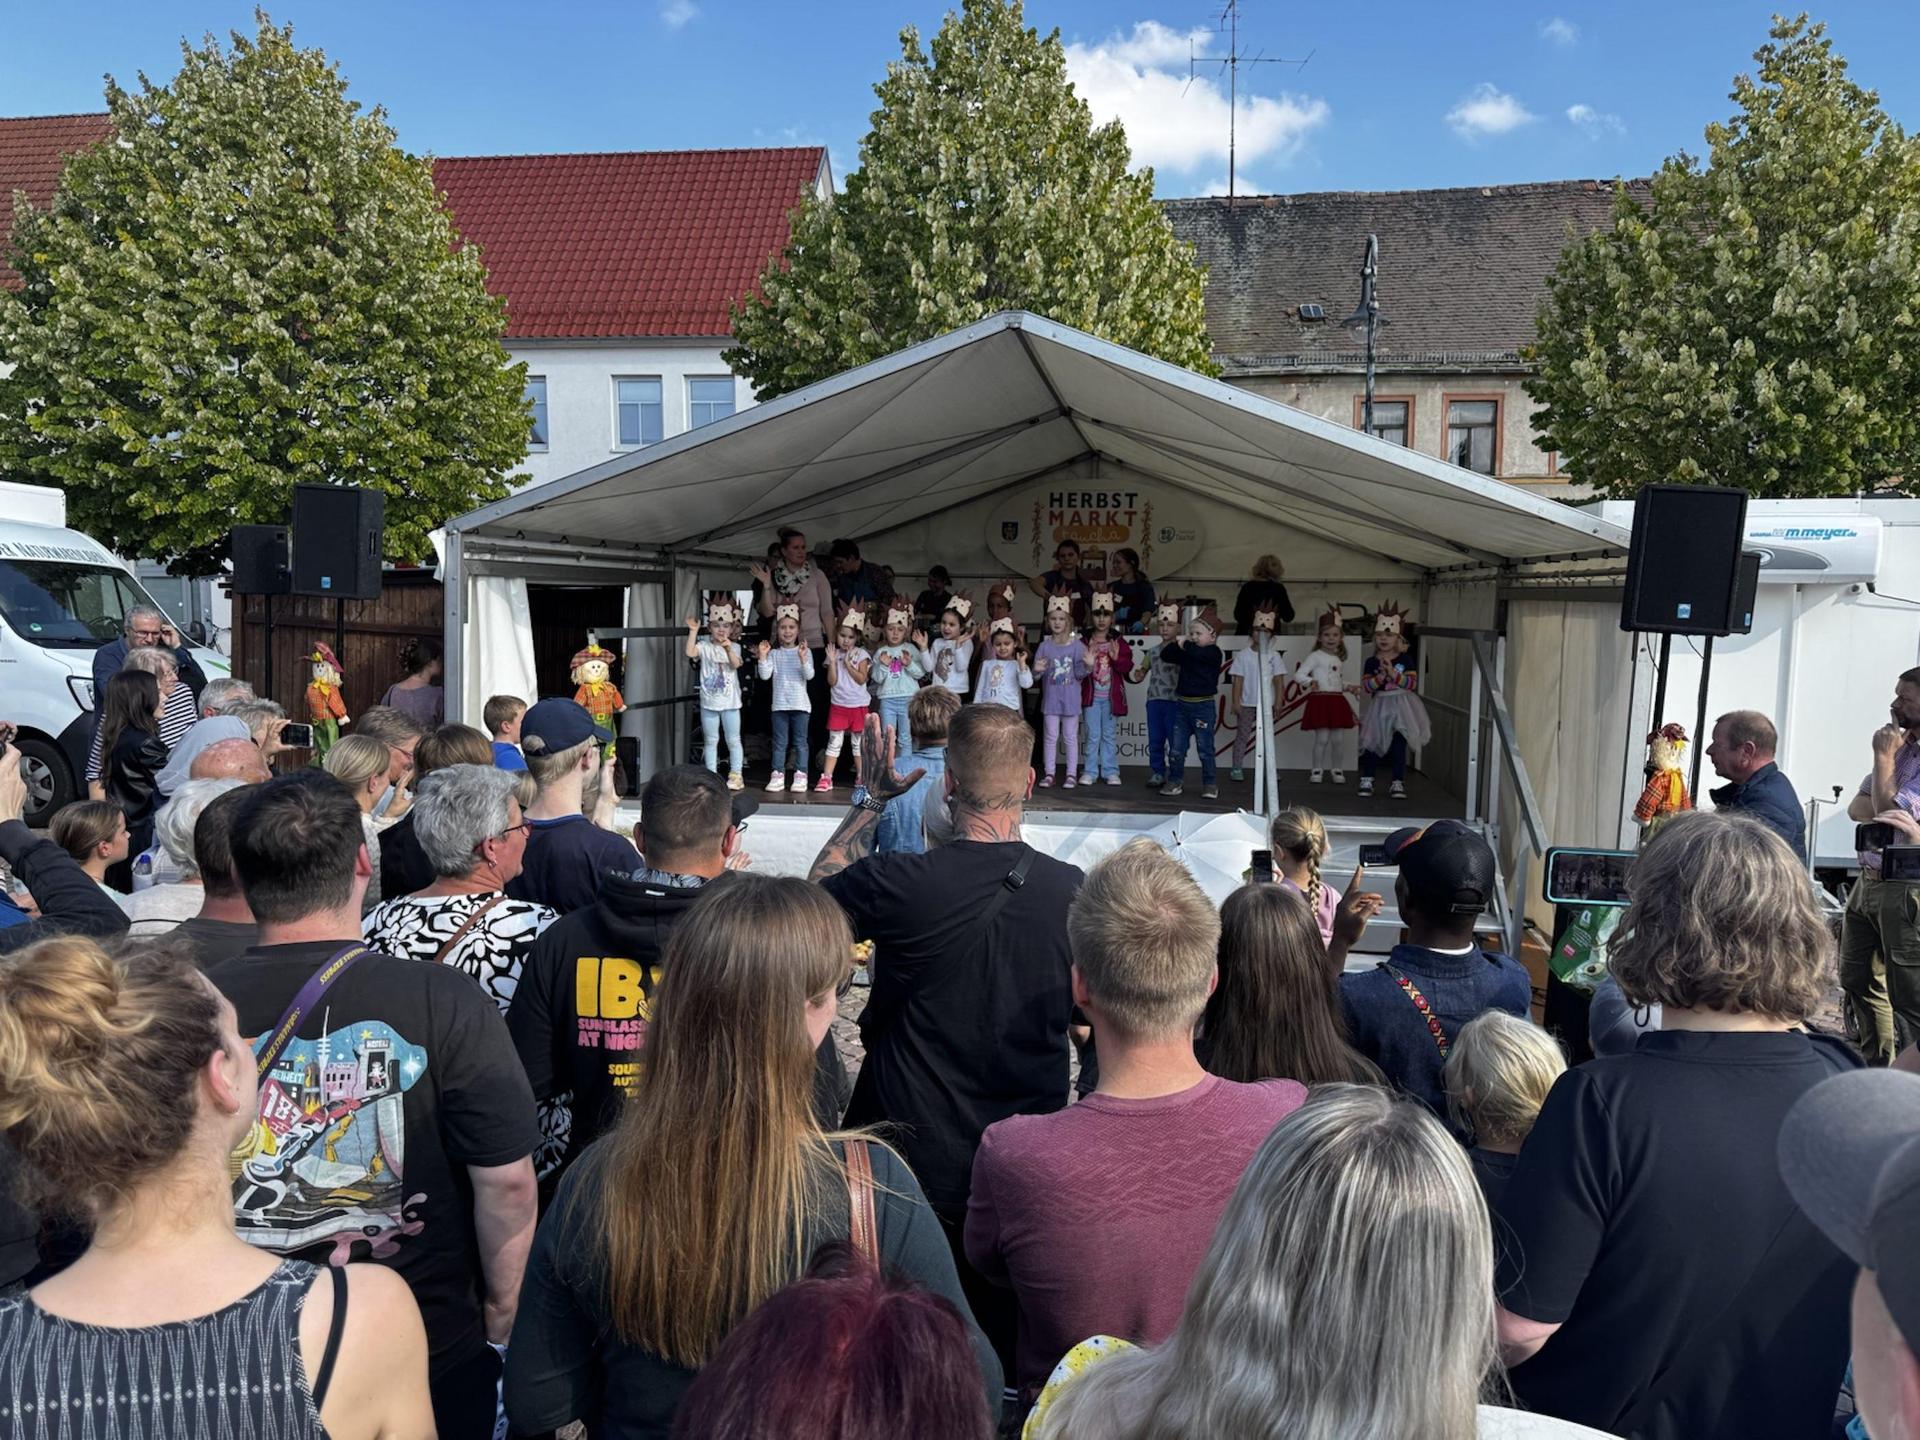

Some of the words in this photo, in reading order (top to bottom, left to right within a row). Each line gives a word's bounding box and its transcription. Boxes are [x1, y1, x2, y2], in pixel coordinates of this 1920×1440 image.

[1049, 492, 1138, 509] HERBST
[1048, 510, 1137, 527] MARKT
[577, 1030, 600, 1048] AT
